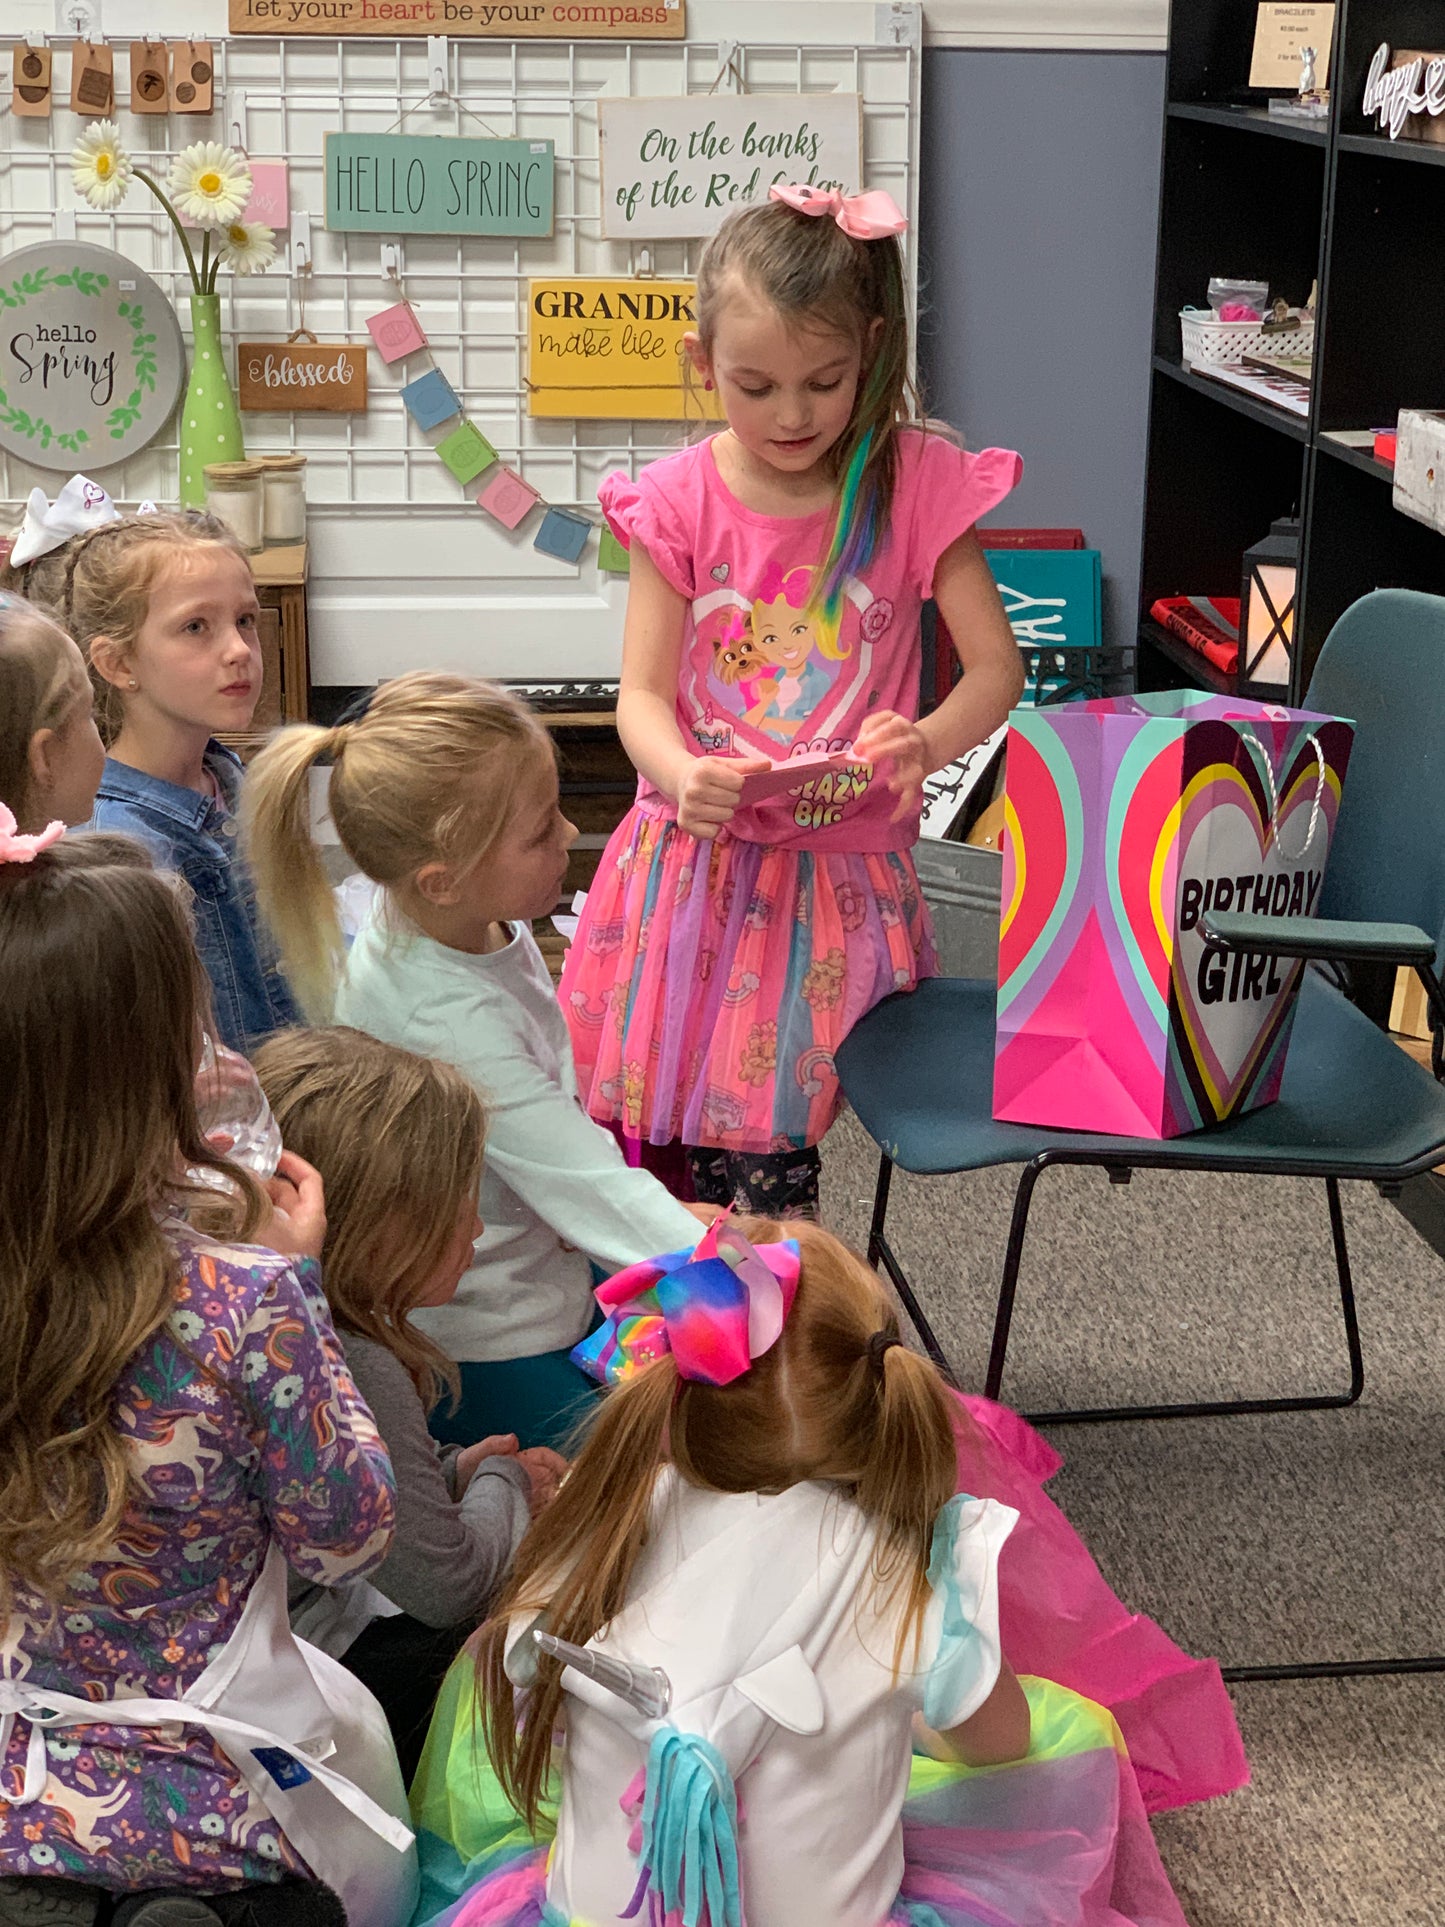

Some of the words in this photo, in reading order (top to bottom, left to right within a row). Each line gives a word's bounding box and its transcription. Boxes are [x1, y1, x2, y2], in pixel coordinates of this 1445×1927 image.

[245, 0, 281, 17] let
[288, 3, 353, 22] your
[360, 0, 436, 20] heart
[444, 0, 473, 22] be
[480, 5, 545, 26] your
[552, 6, 668, 27] compass
[639, 128, 682, 163] On
[688, 120, 735, 160] the
[741, 121, 824, 162] banks
[336, 156, 425, 214] HELLO
[446, 160, 541, 219] SPRING
[616, 181, 645, 222] of
[651, 169, 697, 209] the
[704, 167, 761, 208] Red
[534, 290, 698, 322] GRANDK
[36, 324, 97, 344] hello
[538, 327, 613, 357] make
[621, 324, 667, 360] life
[10, 333, 119, 406] Spring
[248, 352, 354, 388] blessed
[1180, 869, 1322, 932] BIRTHDAY
[1197, 946, 1281, 1005] GIRL
